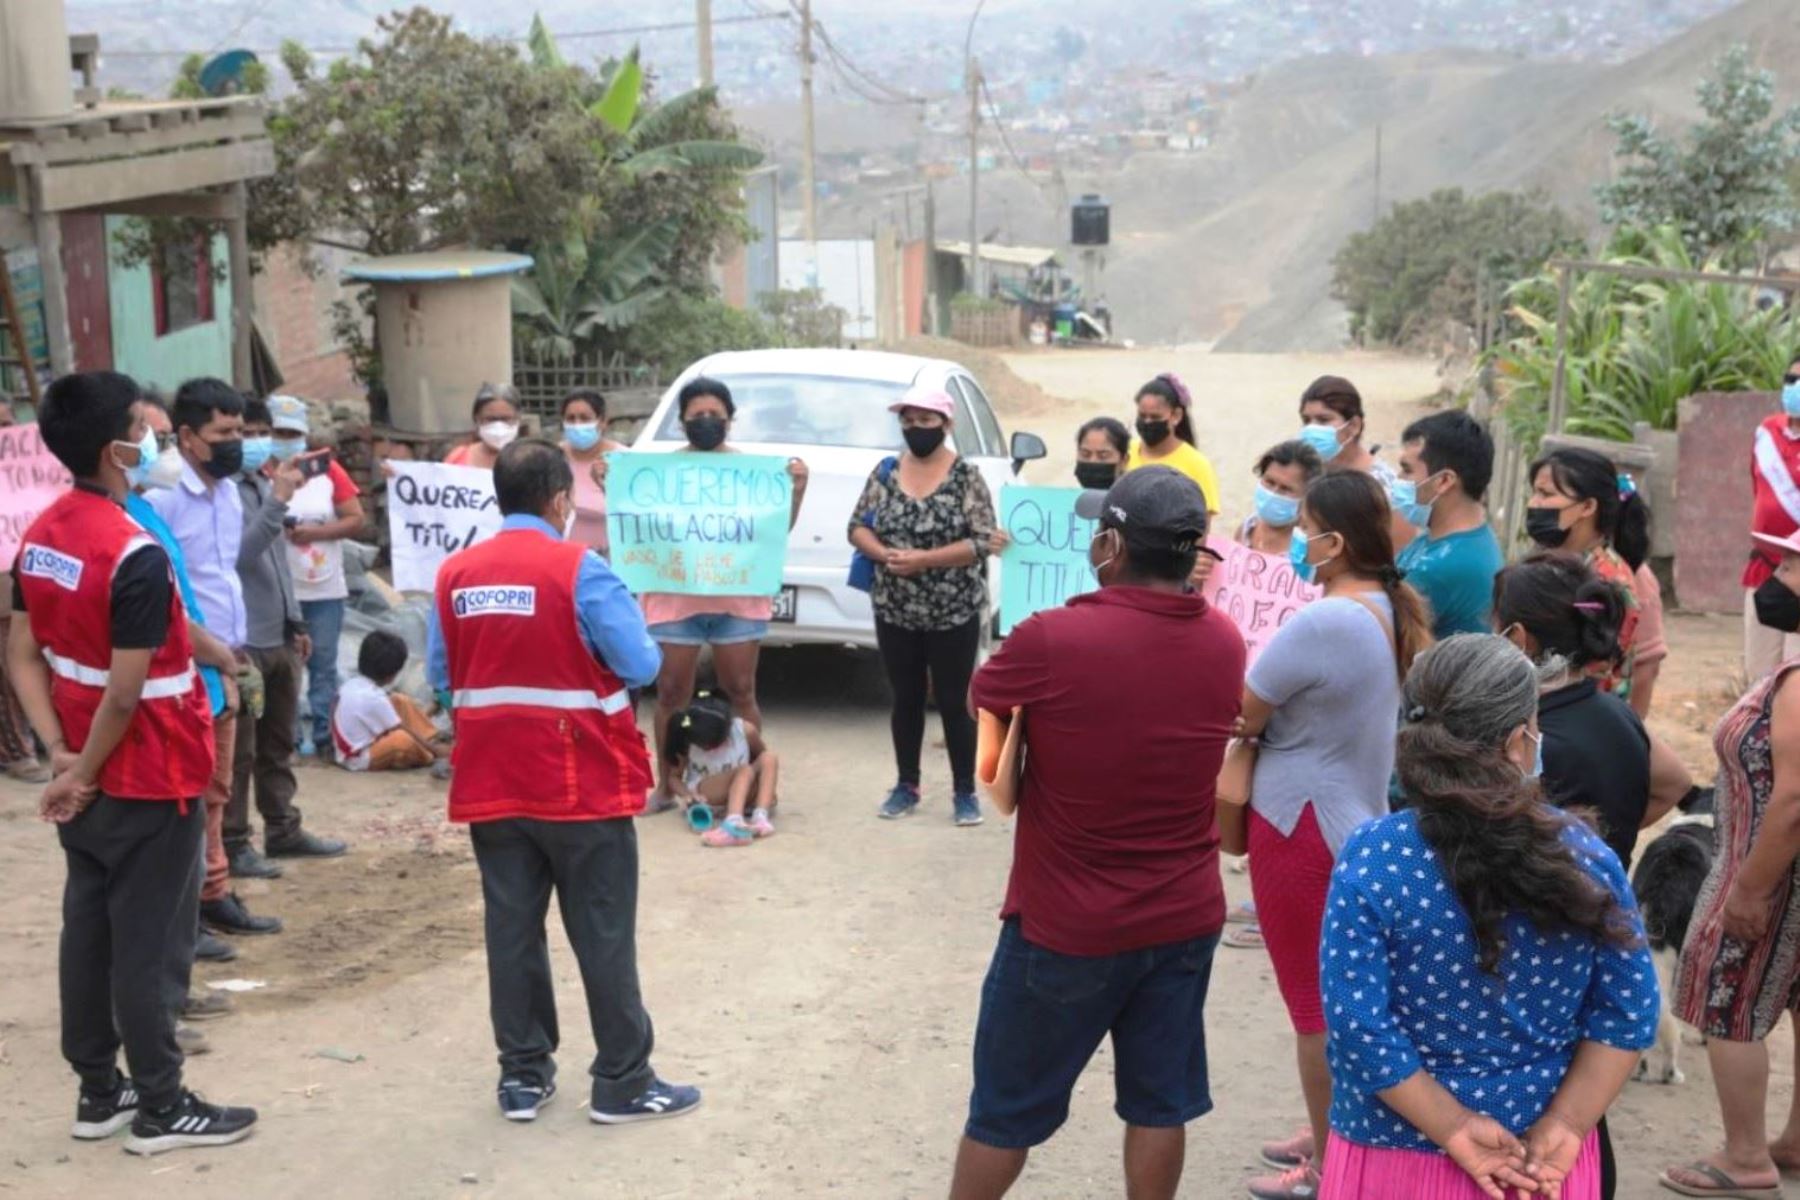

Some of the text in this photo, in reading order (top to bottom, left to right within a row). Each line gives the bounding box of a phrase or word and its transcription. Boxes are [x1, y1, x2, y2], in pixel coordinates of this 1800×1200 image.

[629, 465, 787, 507] QUEREMOS
[609, 511, 754, 545] TITULACIÓN
[1008, 499, 1093, 553] QUE
[467, 589, 532, 607] COFOPRI
